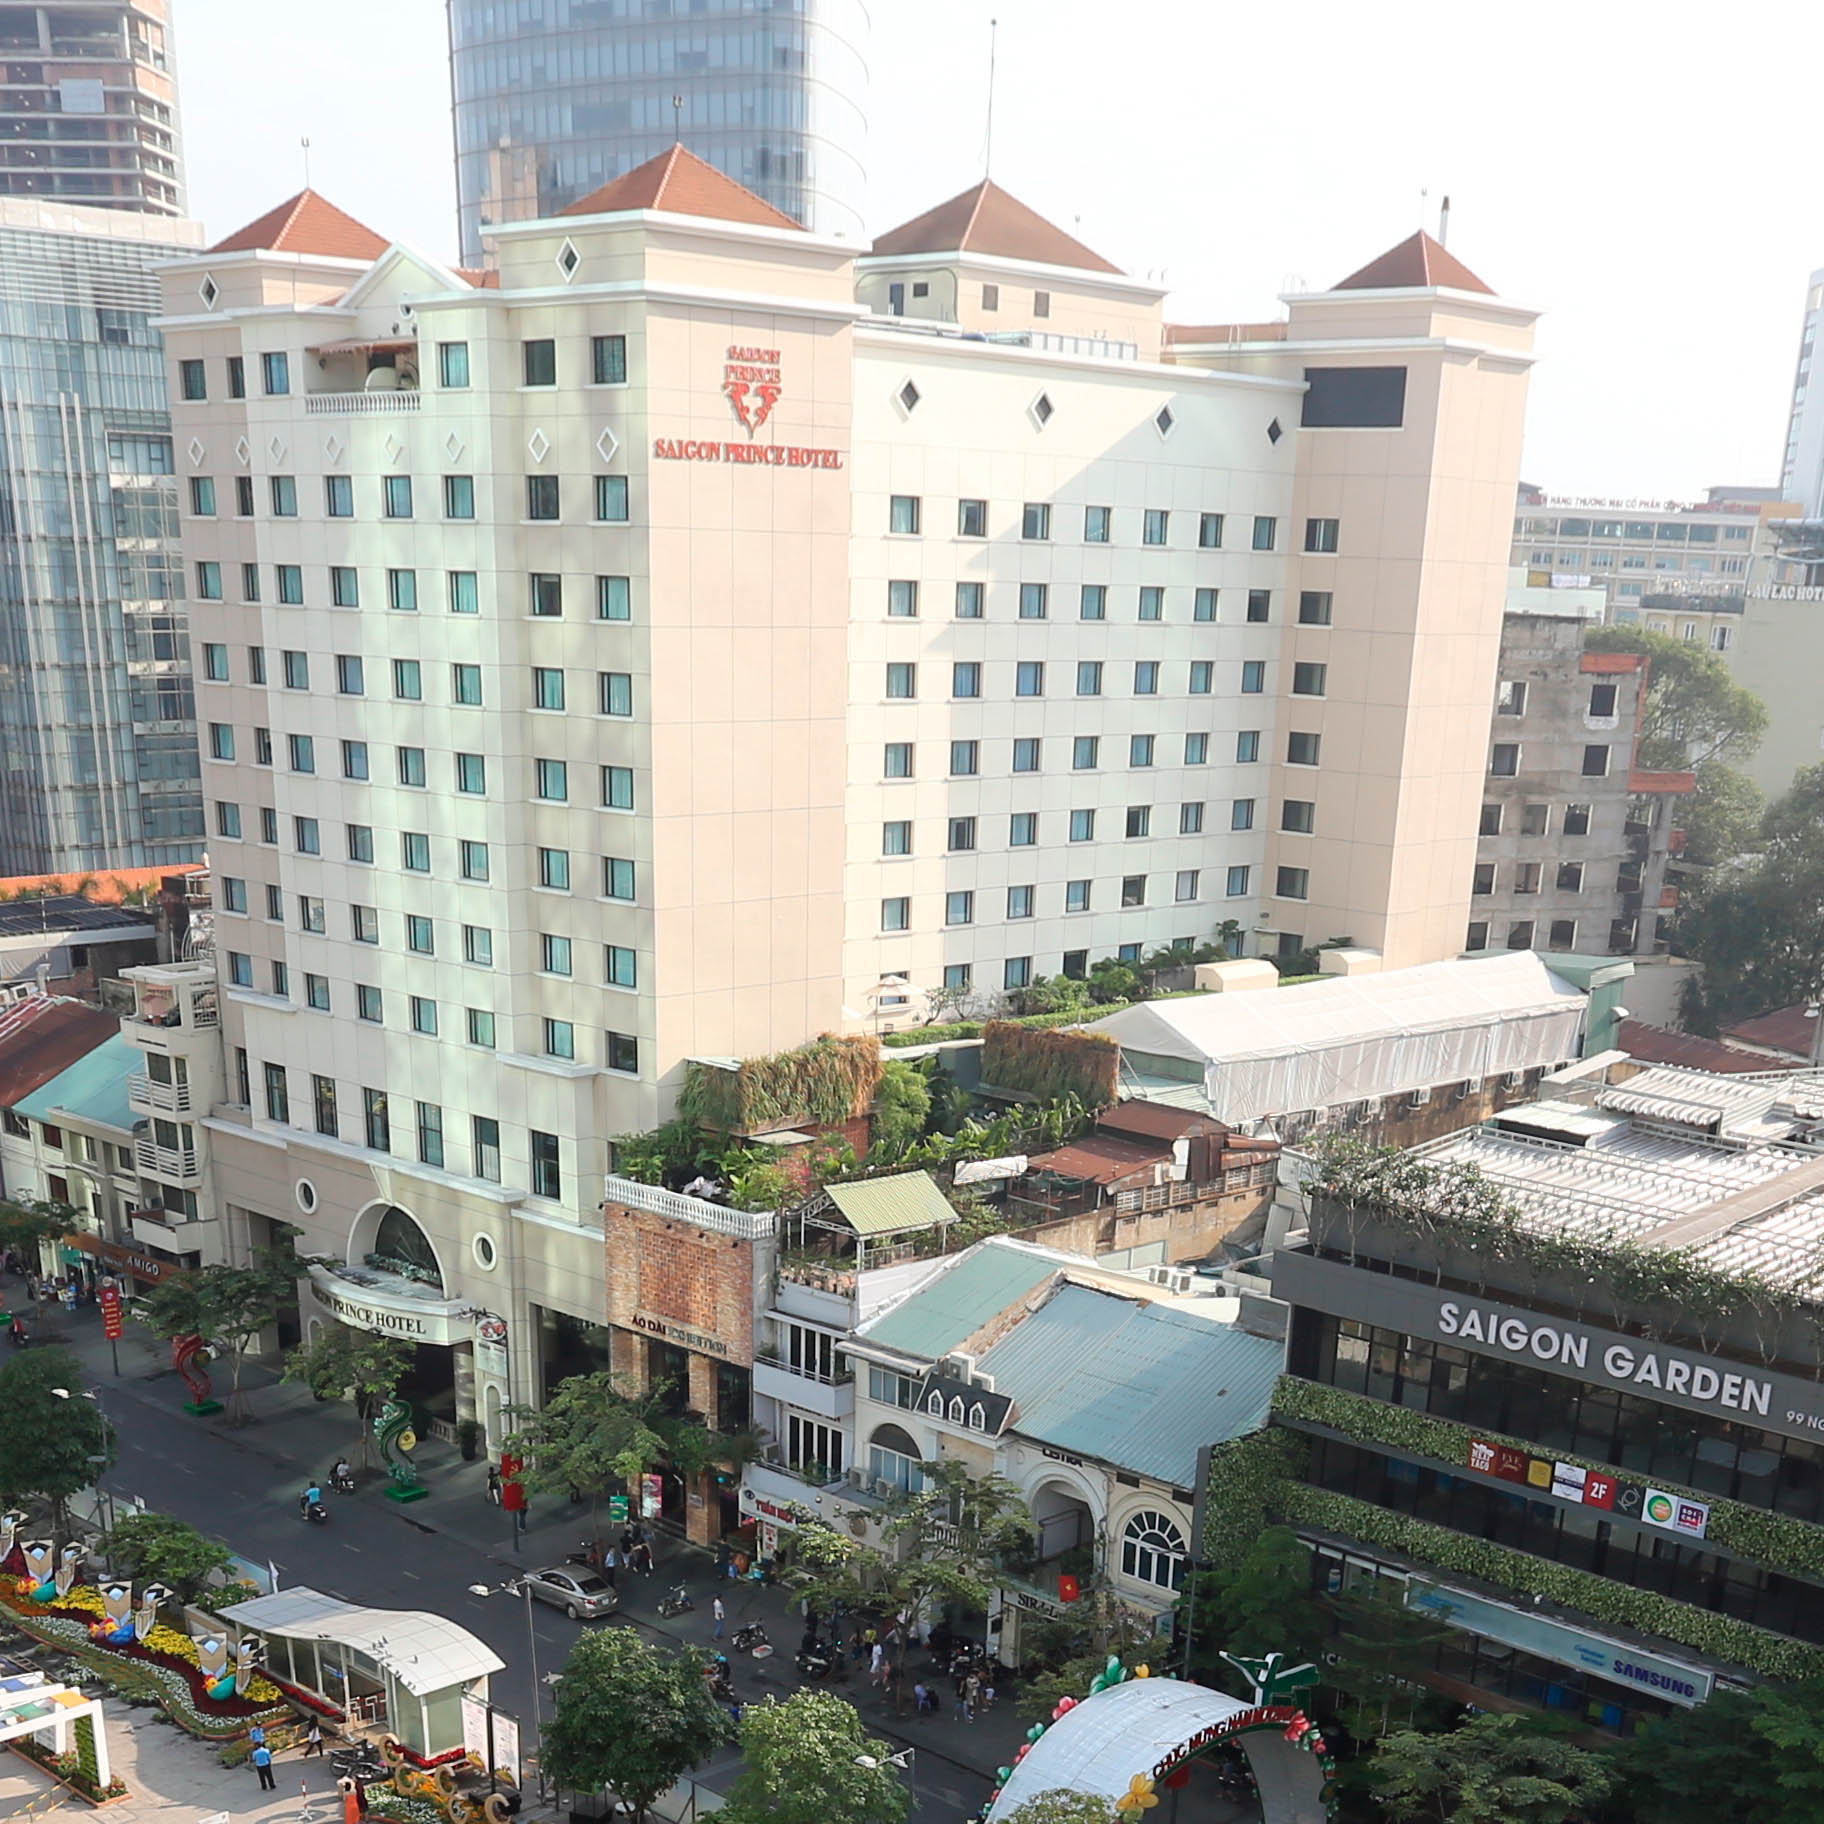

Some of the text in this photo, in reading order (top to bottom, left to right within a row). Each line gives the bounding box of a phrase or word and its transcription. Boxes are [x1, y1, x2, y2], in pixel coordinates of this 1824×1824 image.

[654, 438, 843, 470] SAIGON PRINCE HOTEL
[127, 1256, 160, 1276] AMIGO
[332, 1298, 427, 1335] PRINCE HOTEL
[1438, 1301, 1589, 1369] SAIGON
[1603, 1344, 1773, 1416] GARDEN
[1785, 1409, 1806, 1426] 99
[1590, 1481, 1608, 1500] 2F
[1613, 1659, 1695, 1698] SAMSUNG
